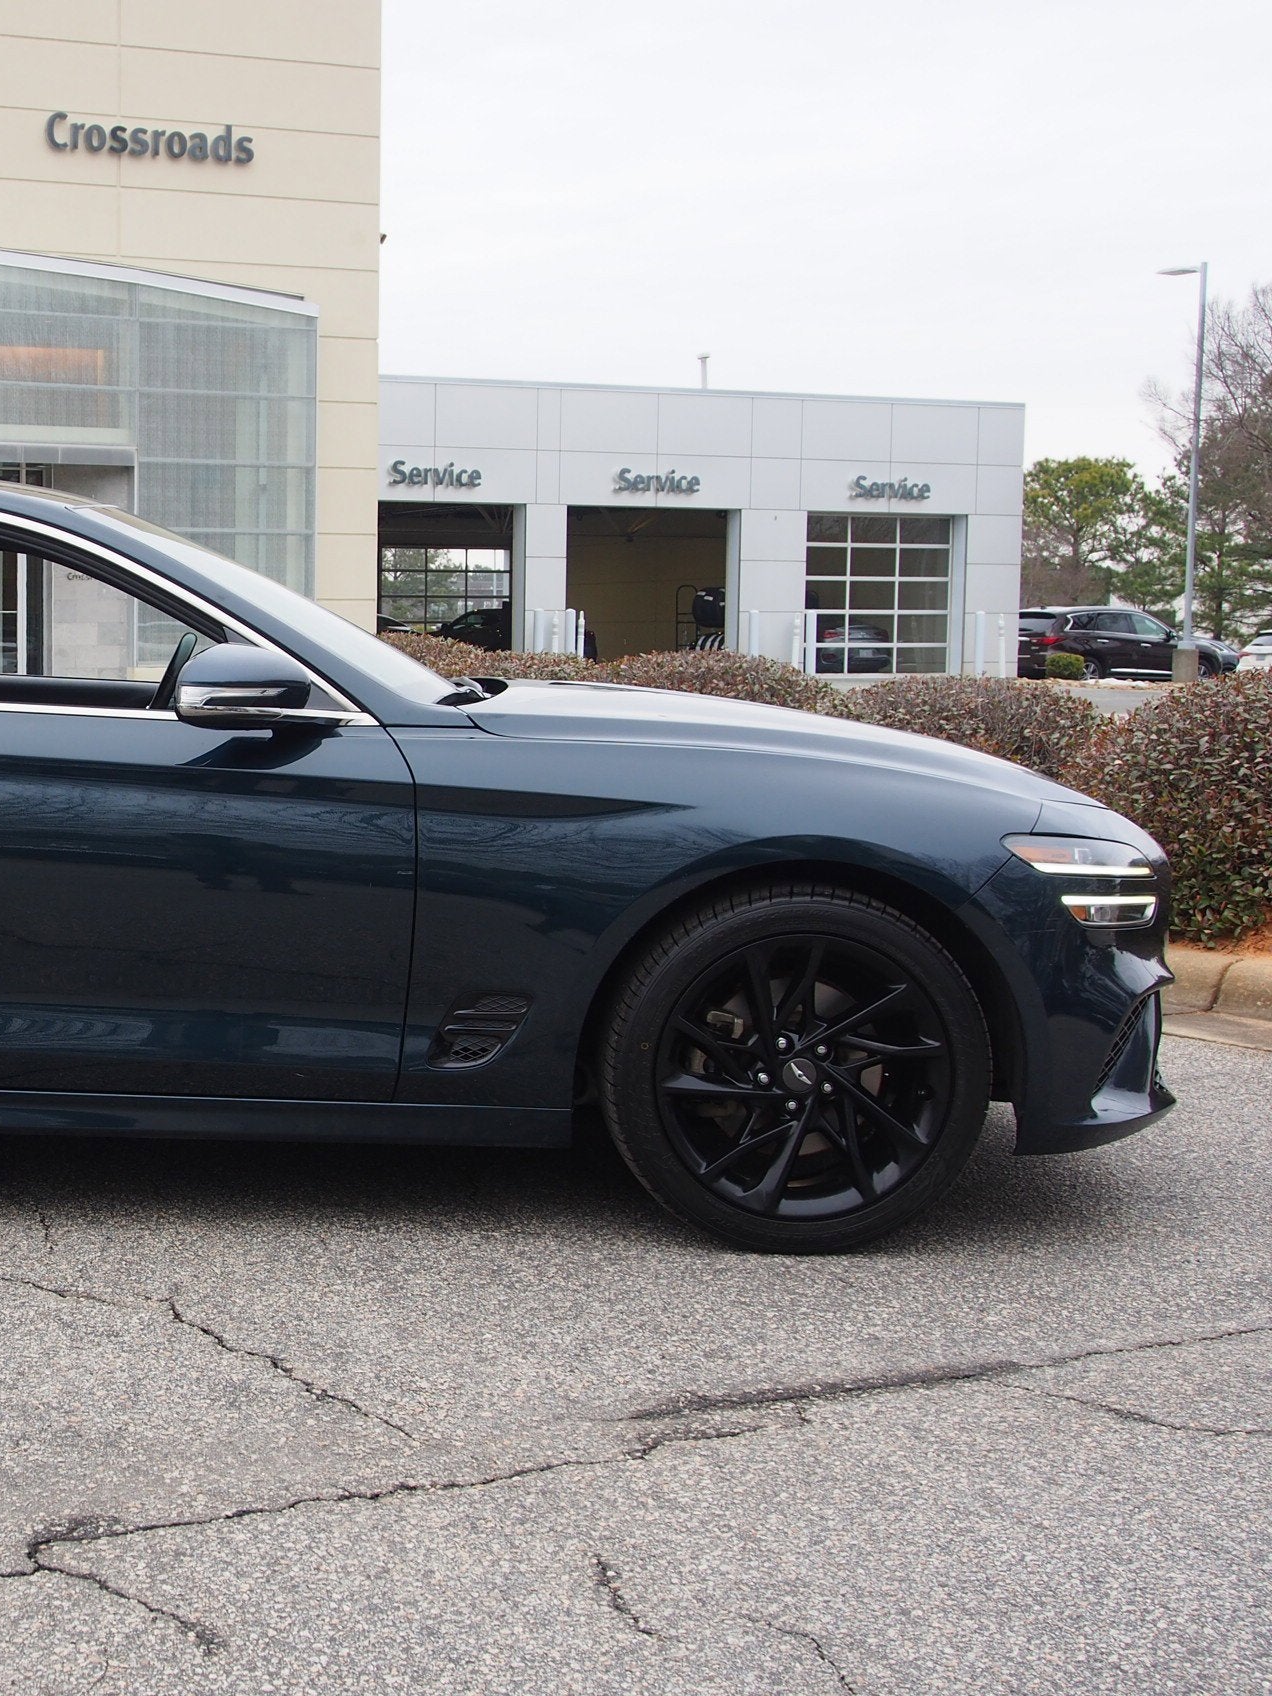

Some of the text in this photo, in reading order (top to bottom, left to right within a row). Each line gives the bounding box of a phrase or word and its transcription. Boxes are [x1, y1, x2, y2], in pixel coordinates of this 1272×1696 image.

[46, 111, 255, 164] Crossroads
[389, 460, 482, 487] Service
[615, 467, 700, 493] Service
[852, 475, 931, 499] Service
